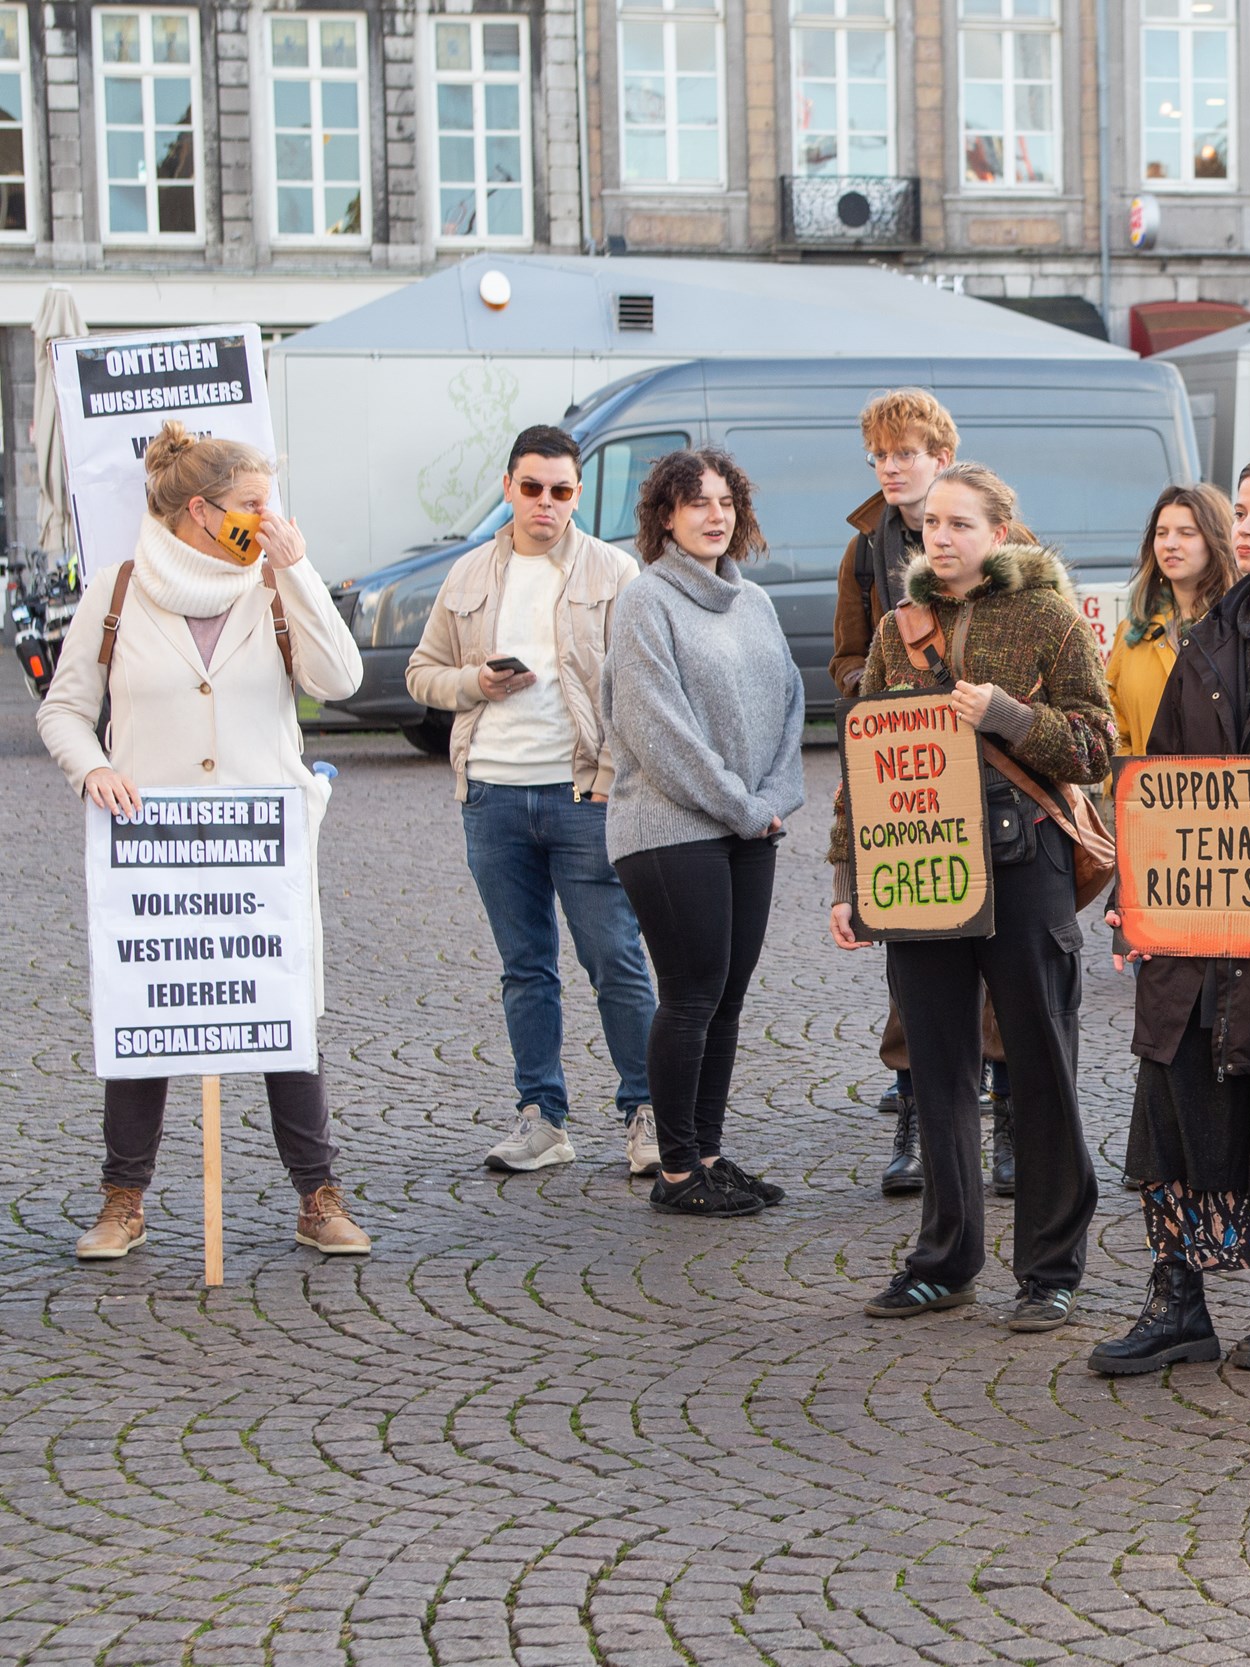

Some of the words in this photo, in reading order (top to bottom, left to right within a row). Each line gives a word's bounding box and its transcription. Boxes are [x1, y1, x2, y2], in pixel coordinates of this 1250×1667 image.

[105, 342, 219, 377] ONTEIGEN
[90, 380, 244, 414] HUISJESMELKERS
[849, 704, 961, 740] COMMUNITY
[874, 743, 946, 784] NEED
[254, 801, 280, 824] DE
[889, 787, 940, 814] OVER
[859, 817, 970, 851] CORPORATE
[115, 839, 279, 864] WONINGMARKT
[872, 854, 969, 909] GREED
[131, 892, 265, 916] VOLKSHUIS-
[117, 937, 214, 963] VESTING
[219, 934, 282, 959] VOOR
[147, 980, 256, 1008] IEDEREEN
[117, 1023, 289, 1056] SOCIALISME.NU
